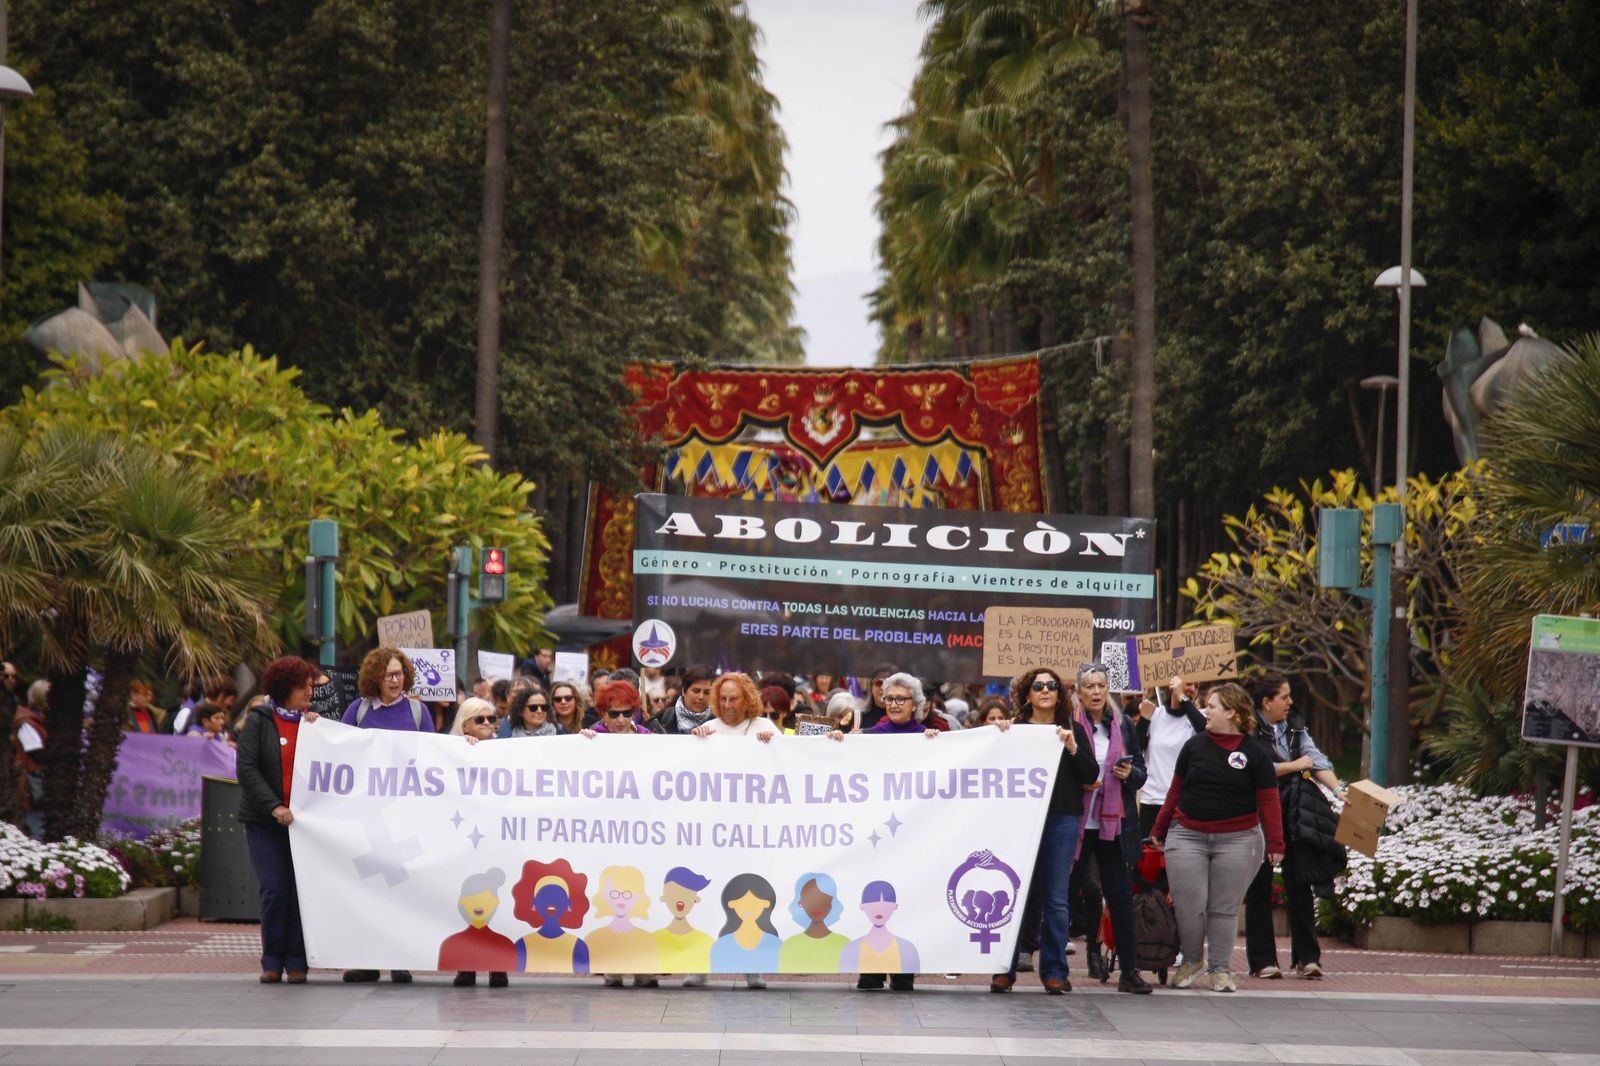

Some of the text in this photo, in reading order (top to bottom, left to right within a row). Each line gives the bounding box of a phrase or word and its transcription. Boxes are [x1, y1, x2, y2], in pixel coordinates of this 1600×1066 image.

[641, 557, 1142, 593] Género Prostitución Pornografía Vientres de alquiler
[647, 595, 1135, 631] SI NO LUCHAS CONTRA TODAS LAS VIOLENCIAS HACIA LA NISMO)
[998, 614, 1016, 627] LA
[740, 622, 983, 648] ERES PARTE DEL PROBLEMA (MAC
[997, 641, 1012, 653] LA
[998, 629, 1013, 639] ES
[1018, 630, 1032, 641] LA
[1137, 626, 1232, 655] LEY TRANS
[997, 654, 1082, 670] ES LA PRÁCTIC
[1143, 654, 1216, 682] MORDAZA
[413, 686, 455, 697] CIONISTA
[161, 747, 200, 785] Soy
[114, 774, 202, 808] femin
[308, 758, 1049, 804] NO MÁS VIOLENCIA CONTRA LAS MUJERES
[500, 816, 855, 849] NI PARAMOS NI CALLAMOS
[988, 911, 1013, 928] FEMINIST
